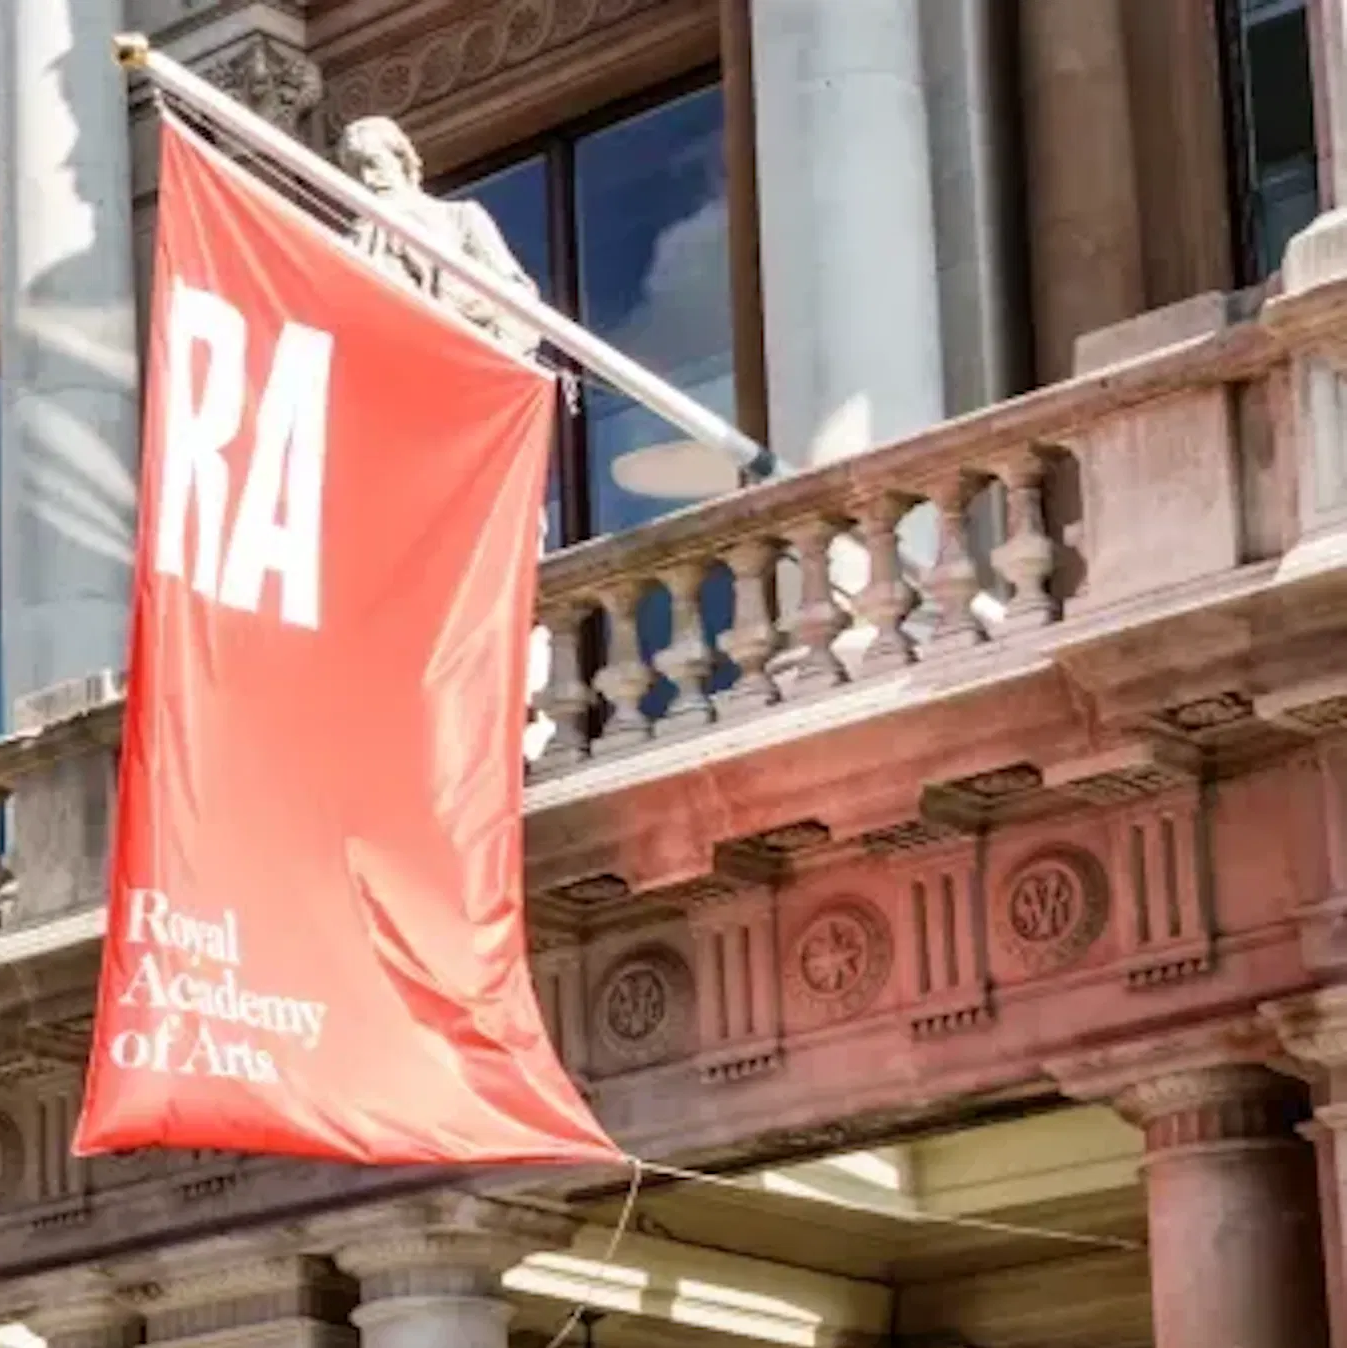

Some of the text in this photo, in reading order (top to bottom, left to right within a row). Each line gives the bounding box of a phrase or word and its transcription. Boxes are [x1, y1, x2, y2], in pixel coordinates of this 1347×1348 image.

[154, 275, 334, 631] RA
[126, 887, 241, 967] Royal
[118, 951, 328, 1050] Academy
[110, 1013, 280, 1084] of Arts
